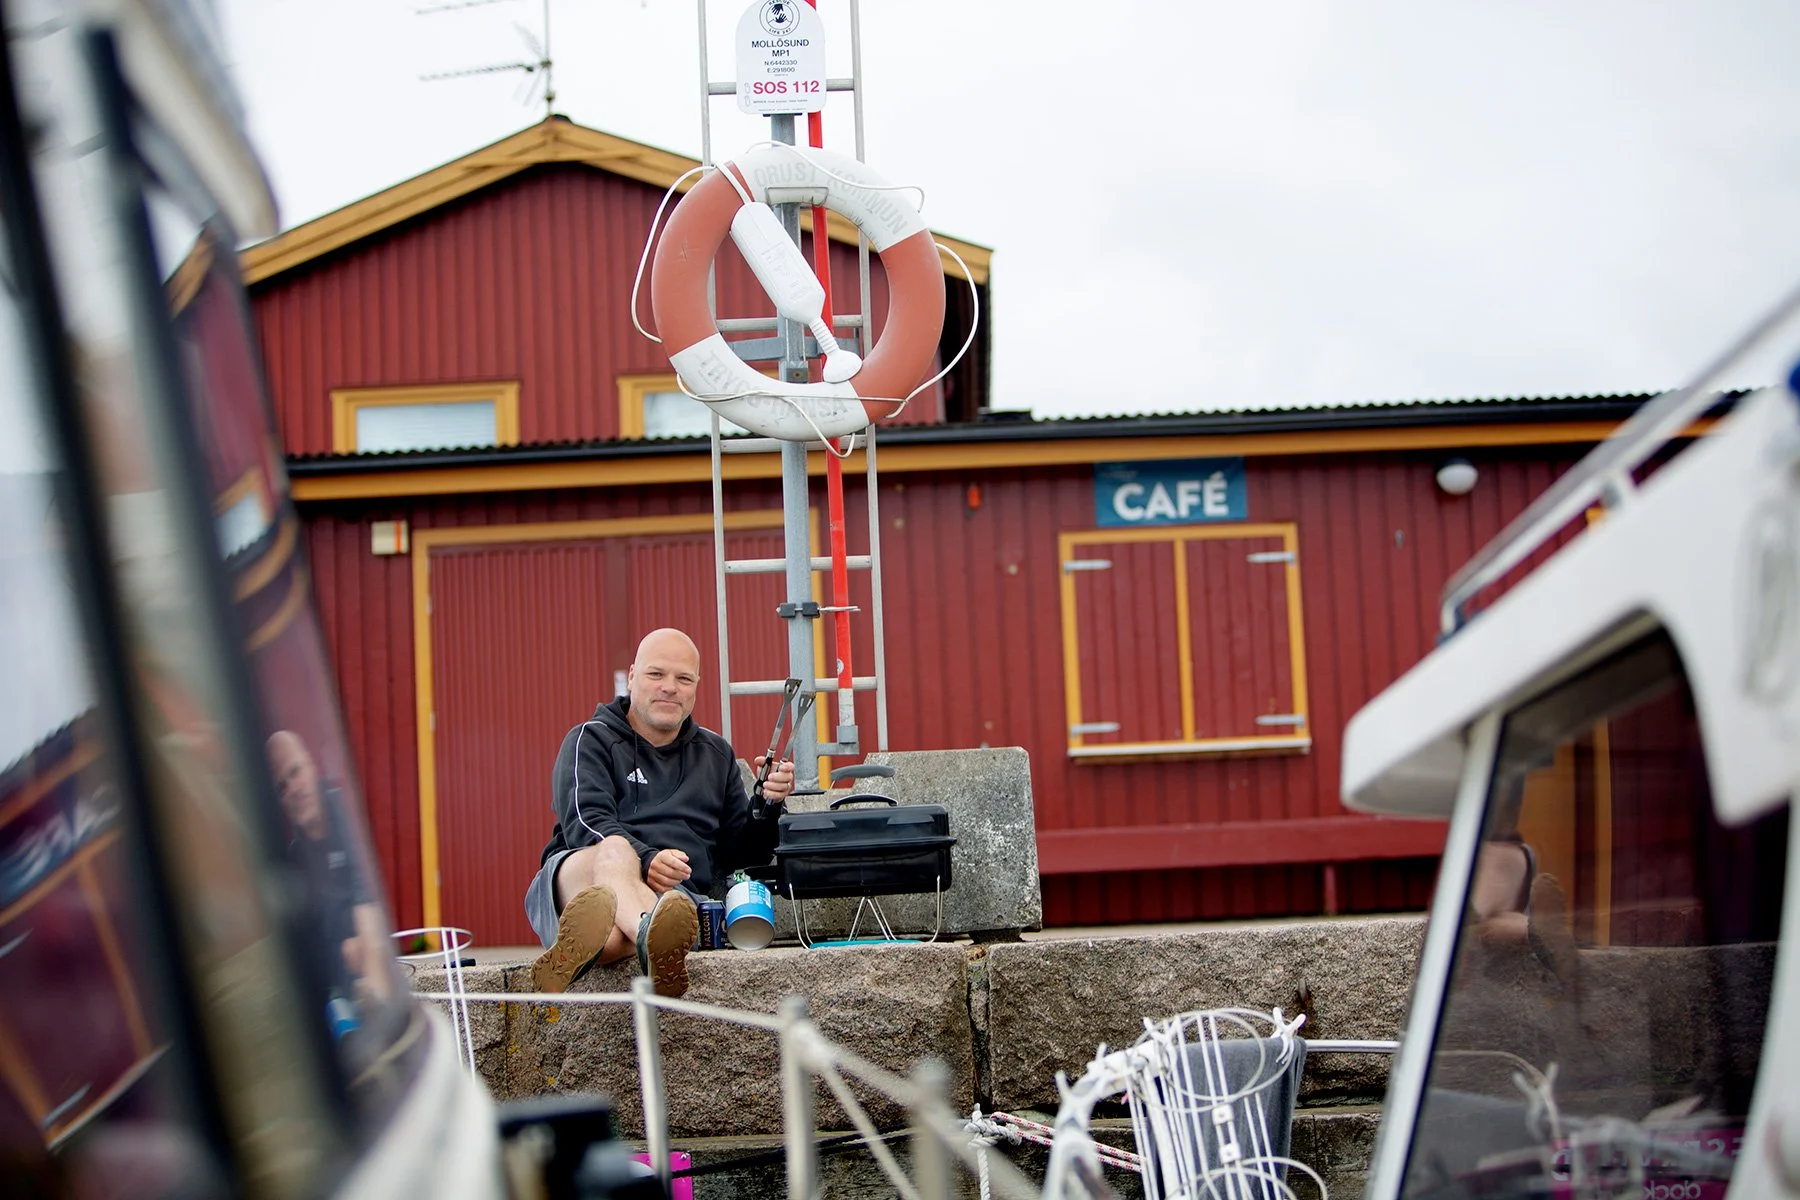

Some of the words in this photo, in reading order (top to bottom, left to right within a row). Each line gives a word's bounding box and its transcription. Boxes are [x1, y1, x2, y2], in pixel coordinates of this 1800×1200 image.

[751, 38, 809, 48] MOLLÖSUND
[753, 81, 787, 94] SOS
[793, 80, 820, 93] 112
[753, 162, 817, 187] ORUST
[1112, 470, 1230, 521] CAFÉ
